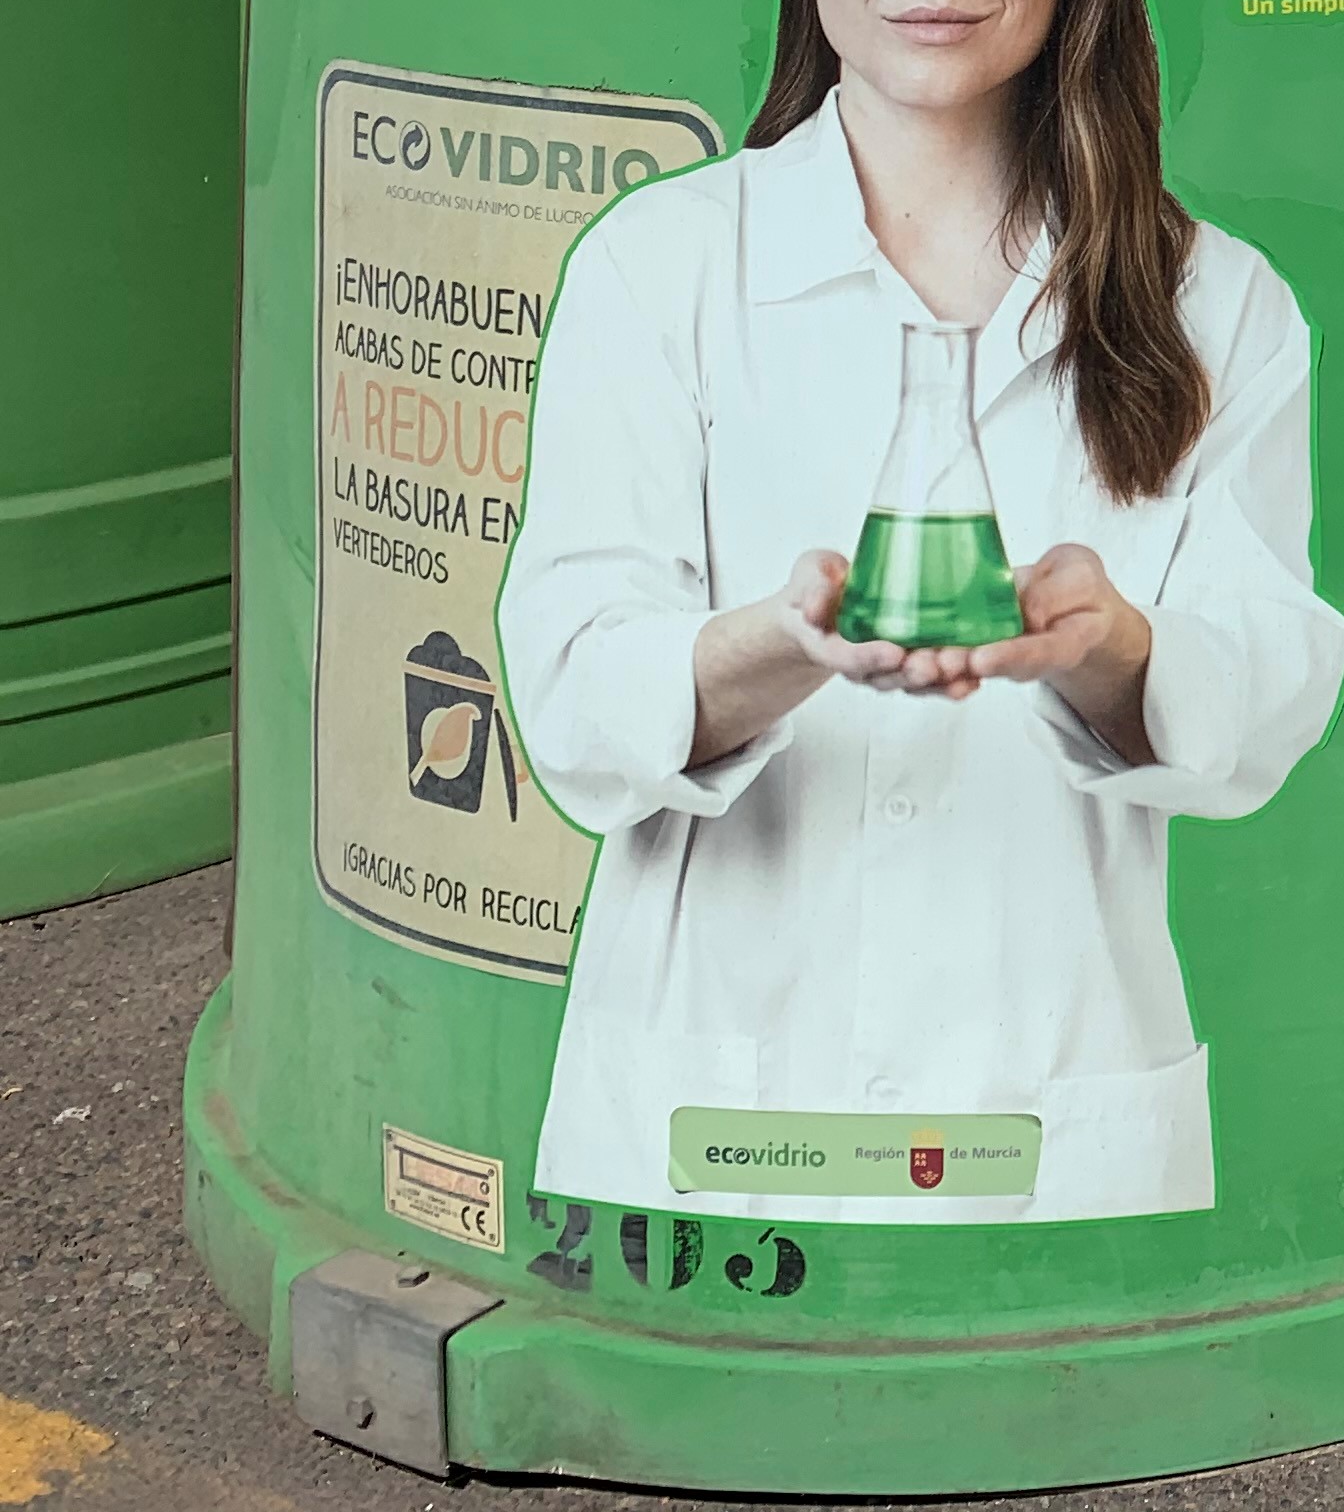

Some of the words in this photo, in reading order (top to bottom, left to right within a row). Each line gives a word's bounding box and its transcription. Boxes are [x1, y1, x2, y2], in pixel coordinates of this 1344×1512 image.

[385, 184, 451, 208] ASOCIACIÓN
[454, 196, 473, 212] SIN
[475, 197, 521, 218] ÁNIMO
[523, 204, 543, 221] DE
[546, 209, 595, 226] LUCRO
[334, 319, 405, 370] ACABAS
[411, 339, 443, 379] DE
[330, 371, 350, 443] A
[365, 379, 525, 484] REDUC
[334, 456, 359, 506] LA
[365, 467, 469, 537] BASURA
[333, 516, 449, 584] VERTEDEROS
[423, 871, 467, 915] POR
[704, 1140, 827, 1169] ecovidrio
[854, 1145, 905, 1162] Región
[949, 1146, 968, 1160] de
[972, 1144, 1022, 1160] Murcia
